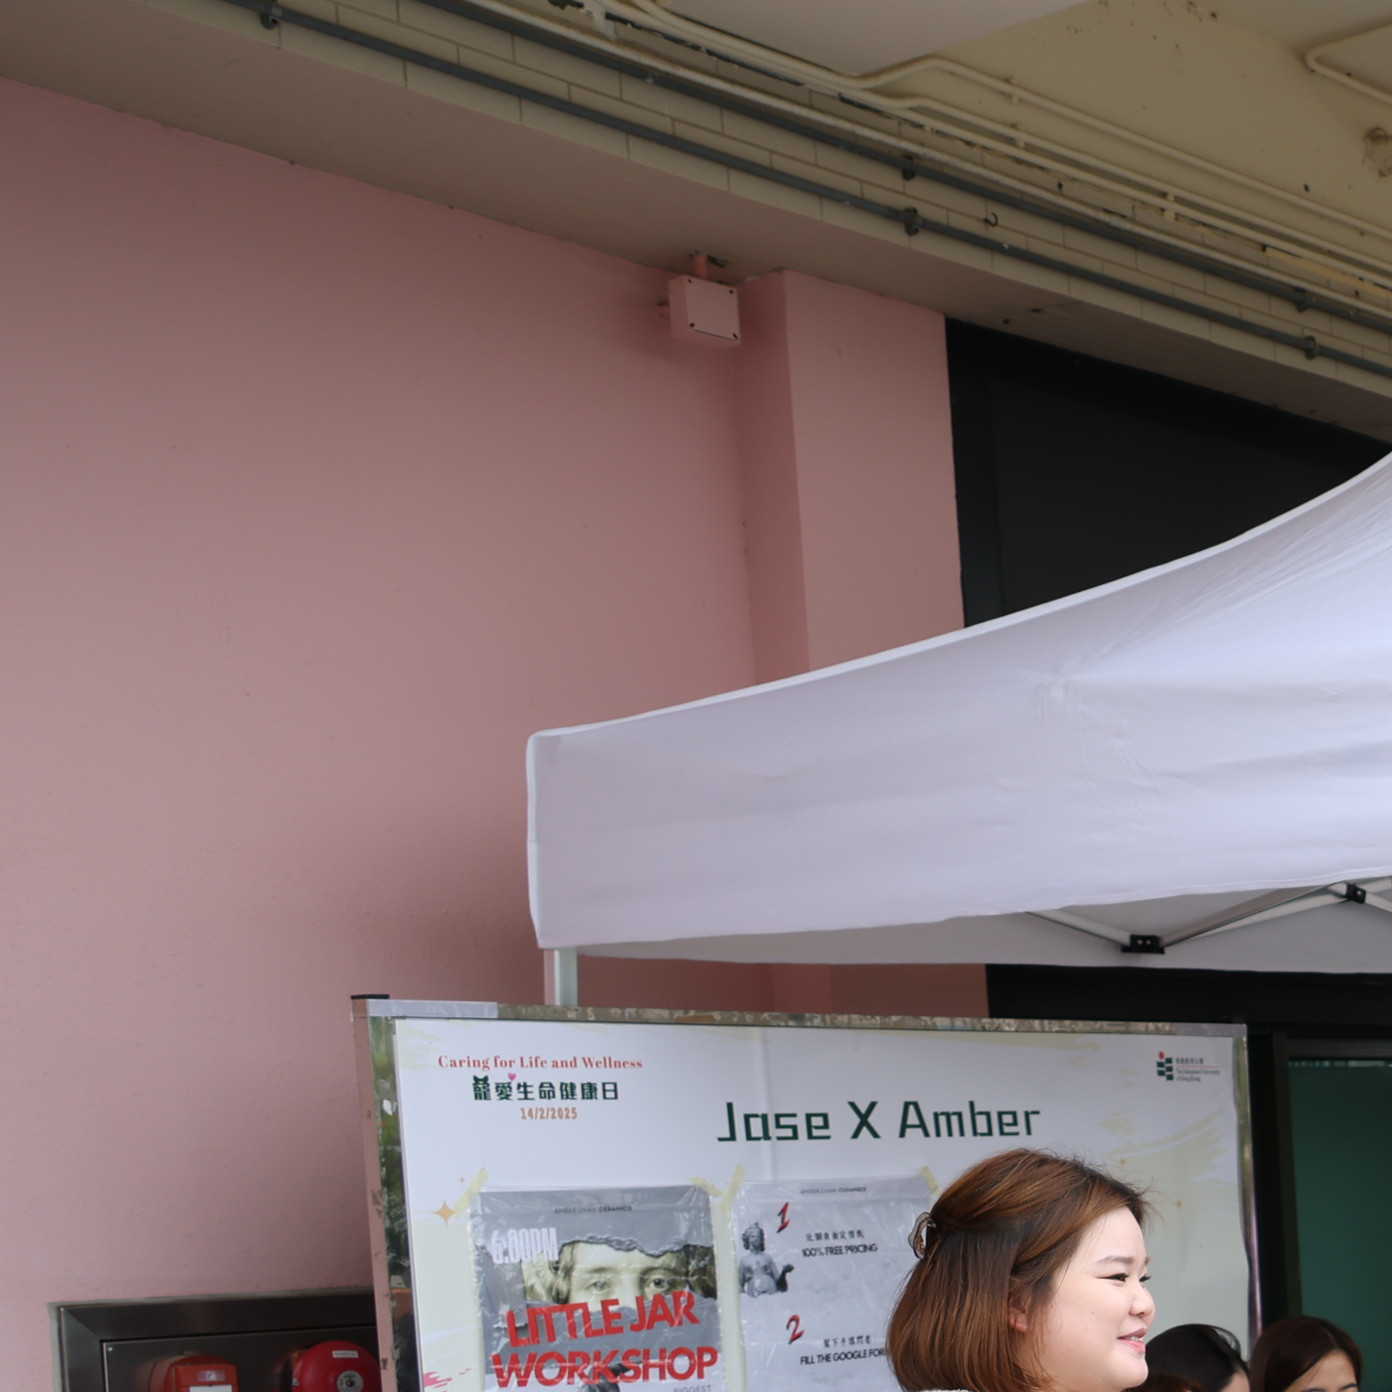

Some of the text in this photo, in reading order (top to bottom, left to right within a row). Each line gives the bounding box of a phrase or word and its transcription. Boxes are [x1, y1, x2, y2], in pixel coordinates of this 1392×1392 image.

[438, 1055, 643, 1071] Caring for Life and Wellness
[472, 1074, 619, 1101] 寵愛生命健康日
[520, 1107, 577, 1120] 14/2/2025
[717, 1100, 1040, 1142] Jase X Amber
[776, 1202, 790, 1233] 1
[802, 1243, 878, 1258] 100% FREE PRICING
[506, 1290, 700, 1348] LITTLE JAR
[786, 1314, 805, 1345] 2
[490, 1346, 718, 1388] WORKSHOP
[800, 1347, 886, 1365] FILL THE GOOGLE FOR
